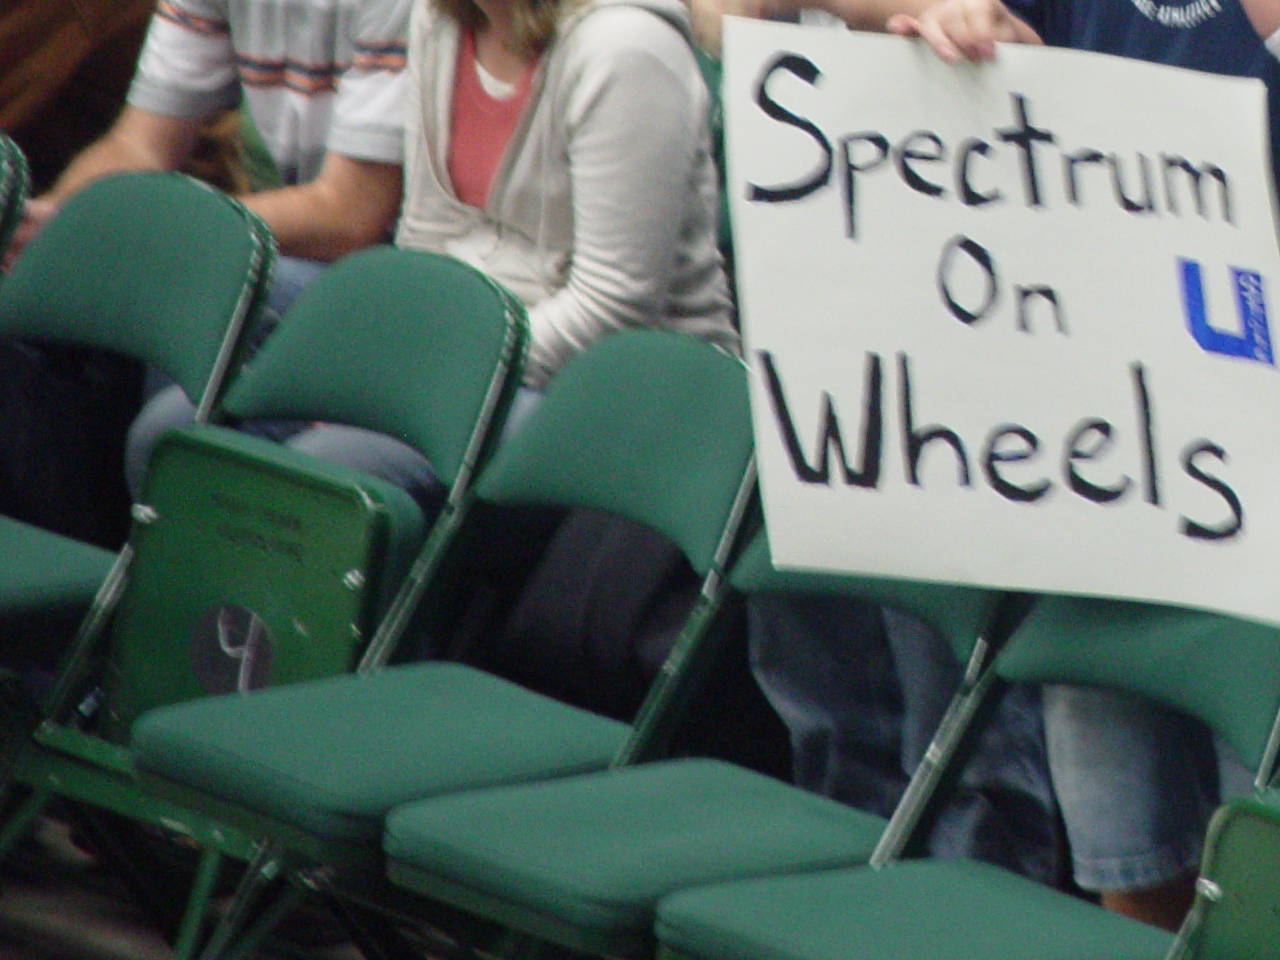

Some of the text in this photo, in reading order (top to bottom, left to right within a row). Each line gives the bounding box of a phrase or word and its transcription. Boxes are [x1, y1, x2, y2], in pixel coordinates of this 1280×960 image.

[745, 50, 1235, 242] Spectrum
[937, 235, 1069, 337] On
[756, 350, 1245, 542] Wheels
